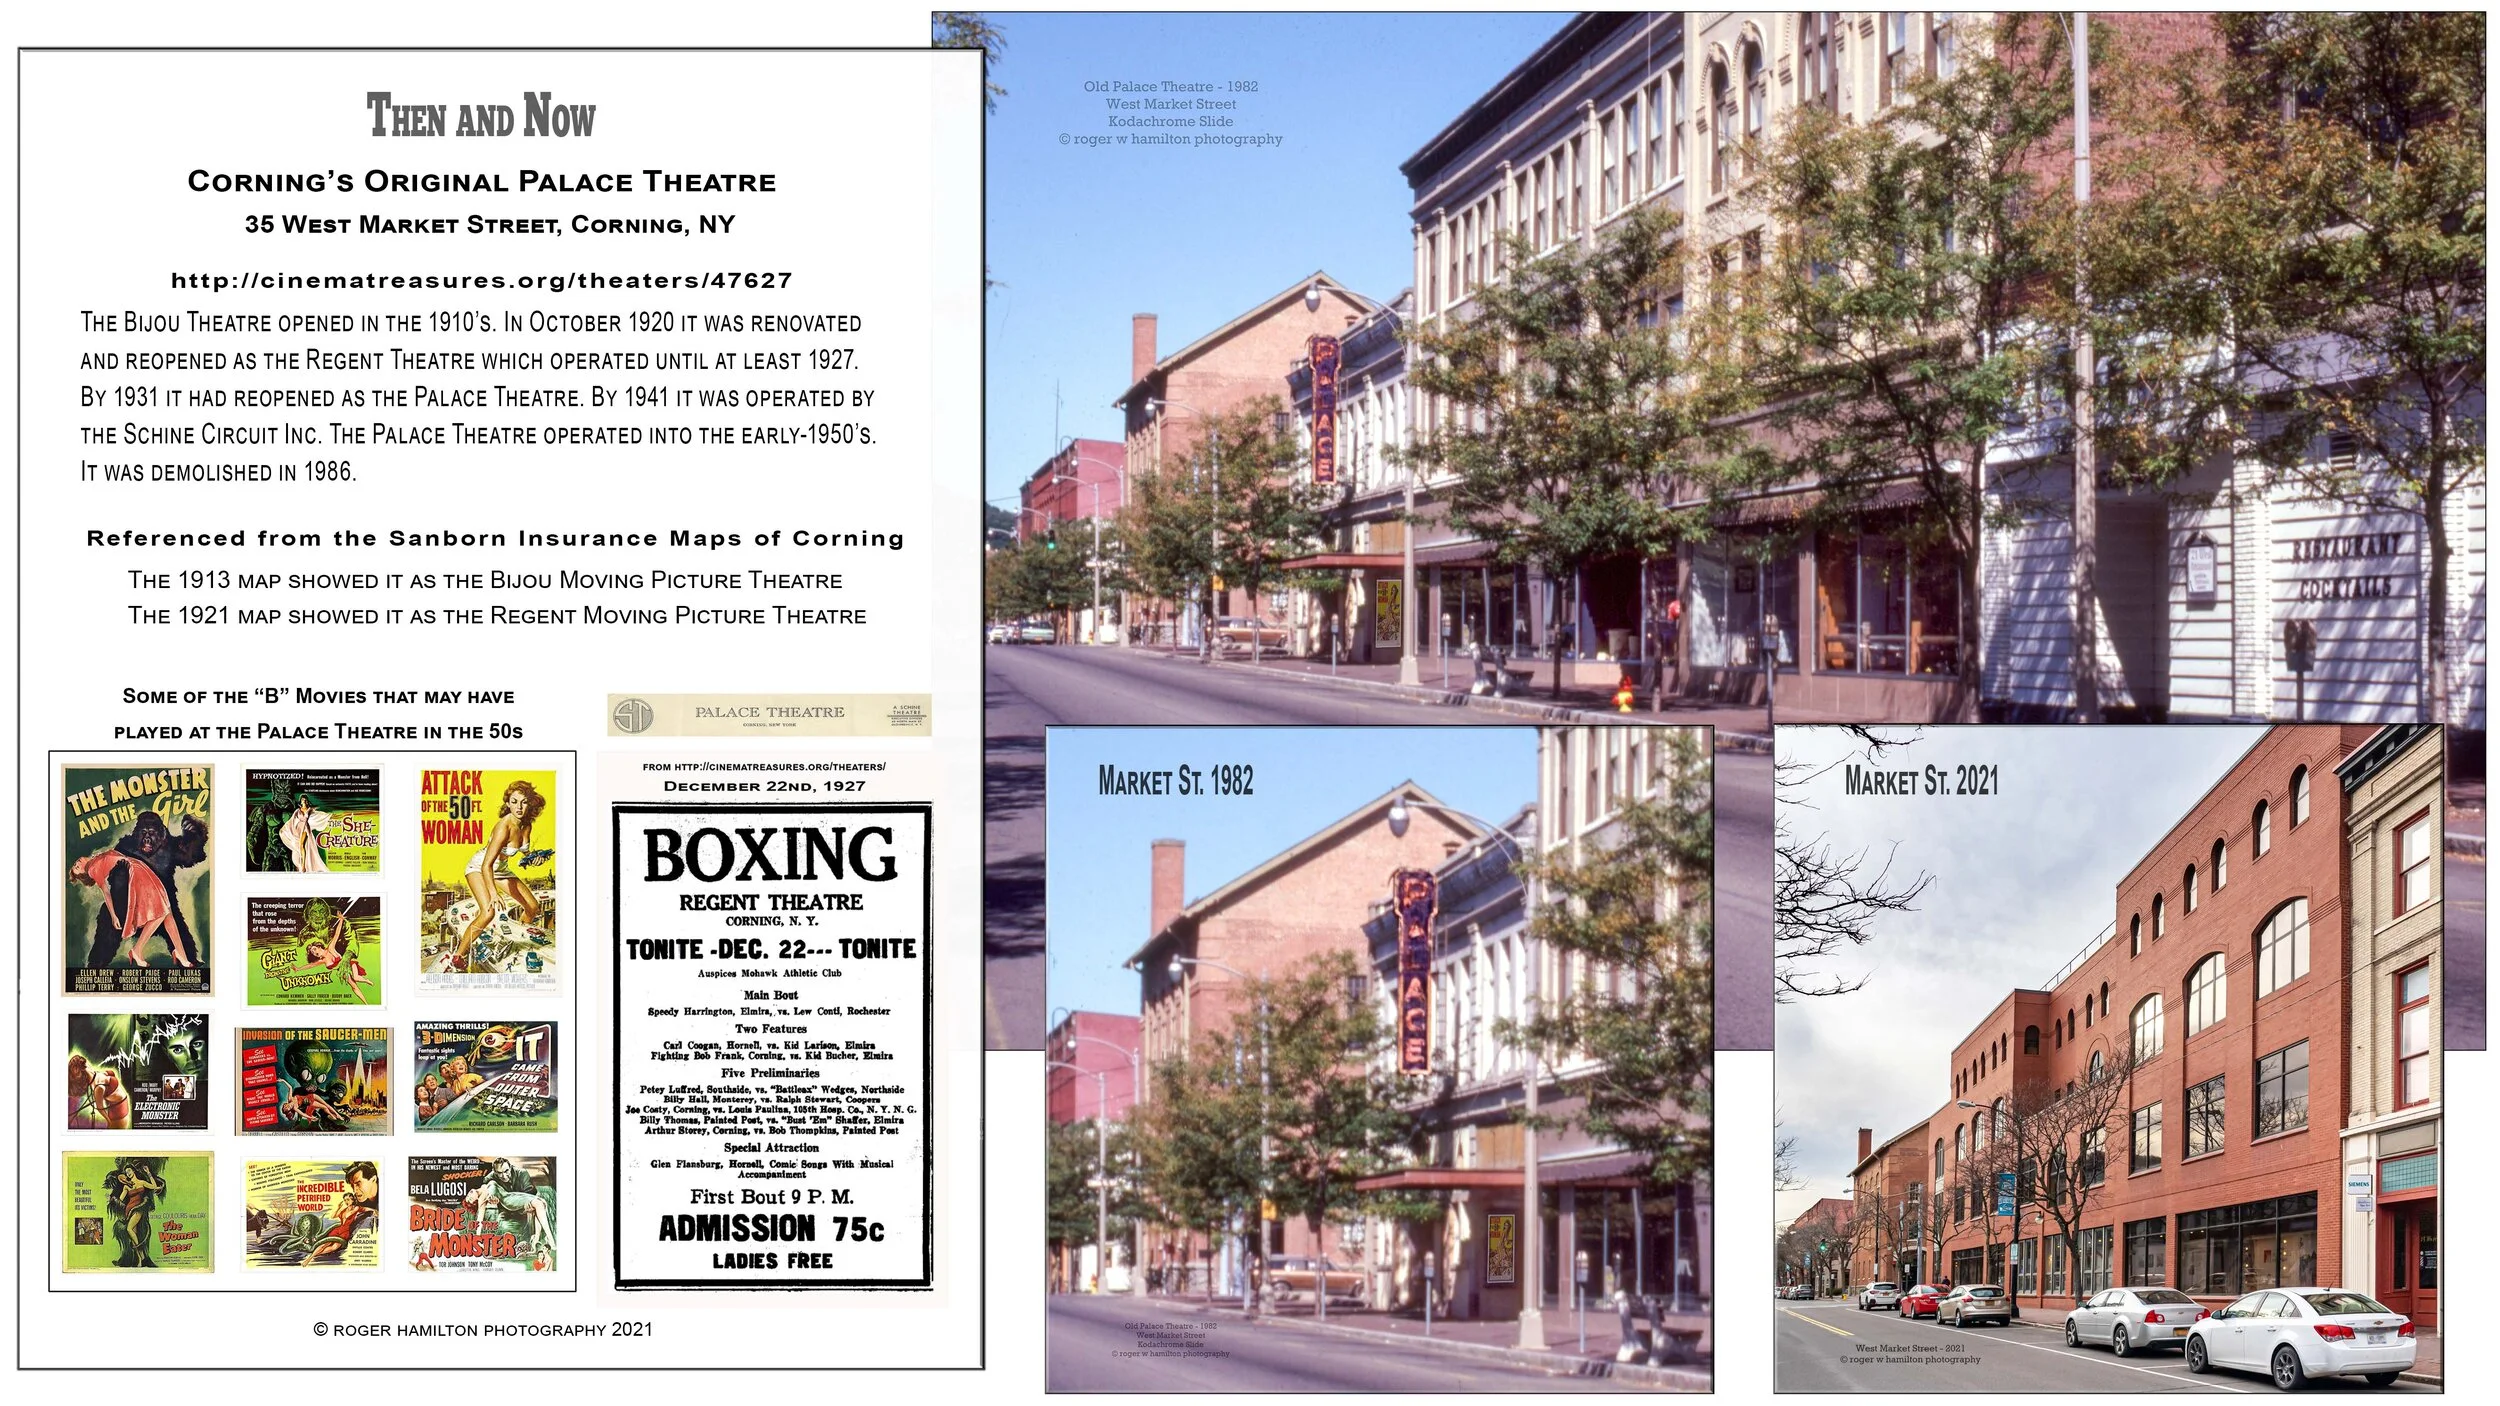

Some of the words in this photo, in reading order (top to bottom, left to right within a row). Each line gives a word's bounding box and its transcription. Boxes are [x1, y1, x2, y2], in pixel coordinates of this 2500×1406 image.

[1314, 342, 1335, 478] PALACE
[2292, 534, 2401, 563] RESTAURANT
[2301, 576, 2391, 603] COCKTAILS
[695, 707, 760, 718] PALACE
[766, 707, 845, 718] THEATRE
[421, 770, 483, 795] ATTACK
[67, 785, 108, 816] THE
[109, 767, 209, 803] MONSTER
[79, 813, 110, 839] AND
[109, 803, 137, 826] THE
[151, 789, 209, 828] Girl
[422, 800, 432, 812] OF
[433, 800, 448, 812] THE
[450, 796, 471, 819] 50
[472, 800, 482, 812] FT.
[328, 820, 341, 828] THE
[421, 820, 483, 844] WOMAN
[315, 832, 379, 850] CREATURE
[644, 826, 899, 883] BOXING
[263, 902, 287, 910] creeping
[679, 894, 760, 912] REGENT
[768, 894, 864, 911] THEATRE
[726, 916, 785, 928] CORNING,
[790, 916, 801, 926] N.
[806, 916, 819, 926] Y.
[626, 939, 704, 960] TONITE
[839, 938, 917, 960] TONITE
[261, 949, 297, 970] GIANT
[1404, 877, 1430, 1064] PALACE
[280, 972, 333, 991] UNKNOWN
[243, 1031, 282, 1040] INVASION
[285, 1031, 296, 1040] OF
[298, 1031, 313, 1040] THE
[316, 1029, 387, 1041] SAUCER-MEN
[422, 1031, 476, 1045] 3-DIMENSION
[516, 1032, 544, 1061] IT
[511, 1063, 544, 1072] CAME
[503, 1073, 540, 1084] FROM
[495, 1084, 540, 1099] OUTER
[134, 1102, 180, 1110] ELECTRONIC
[483, 1094, 535, 1113] SPACE
[141, 1111, 179, 1120] MONSTER
[442, 1170, 488, 1181] SHOCKER!
[296, 1181, 345, 1193] INCREDIBLE
[410, 1184, 429, 1194] BELA
[431, 1182, 467, 1196] LUGOSI
[297, 1194, 330, 1202] PETRIFIED
[691, 1189, 734, 1205] First
[741, 1189, 785, 1205] Bout
[792, 1189, 800, 1204] 9
[808, 1189, 825, 1204] P.
[832, 1189, 854, 1204] M.
[297, 1203, 323, 1211] WORLD
[163, 1221, 183, 1232] The
[410, 1204, 466, 1232] BRIDE
[481, 1221, 498, 1230] THE
[659, 1214, 816, 1242] ADMISSION
[833, 1216, 885, 1242] 75c
[158, 1231, 199, 1243] Woman
[429, 1232, 516, 1258] MONSTER
[163, 1243, 192, 1255] Eater
[713, 1252, 778, 1269] LADIES
[787, 1252, 833, 1269] FREE
